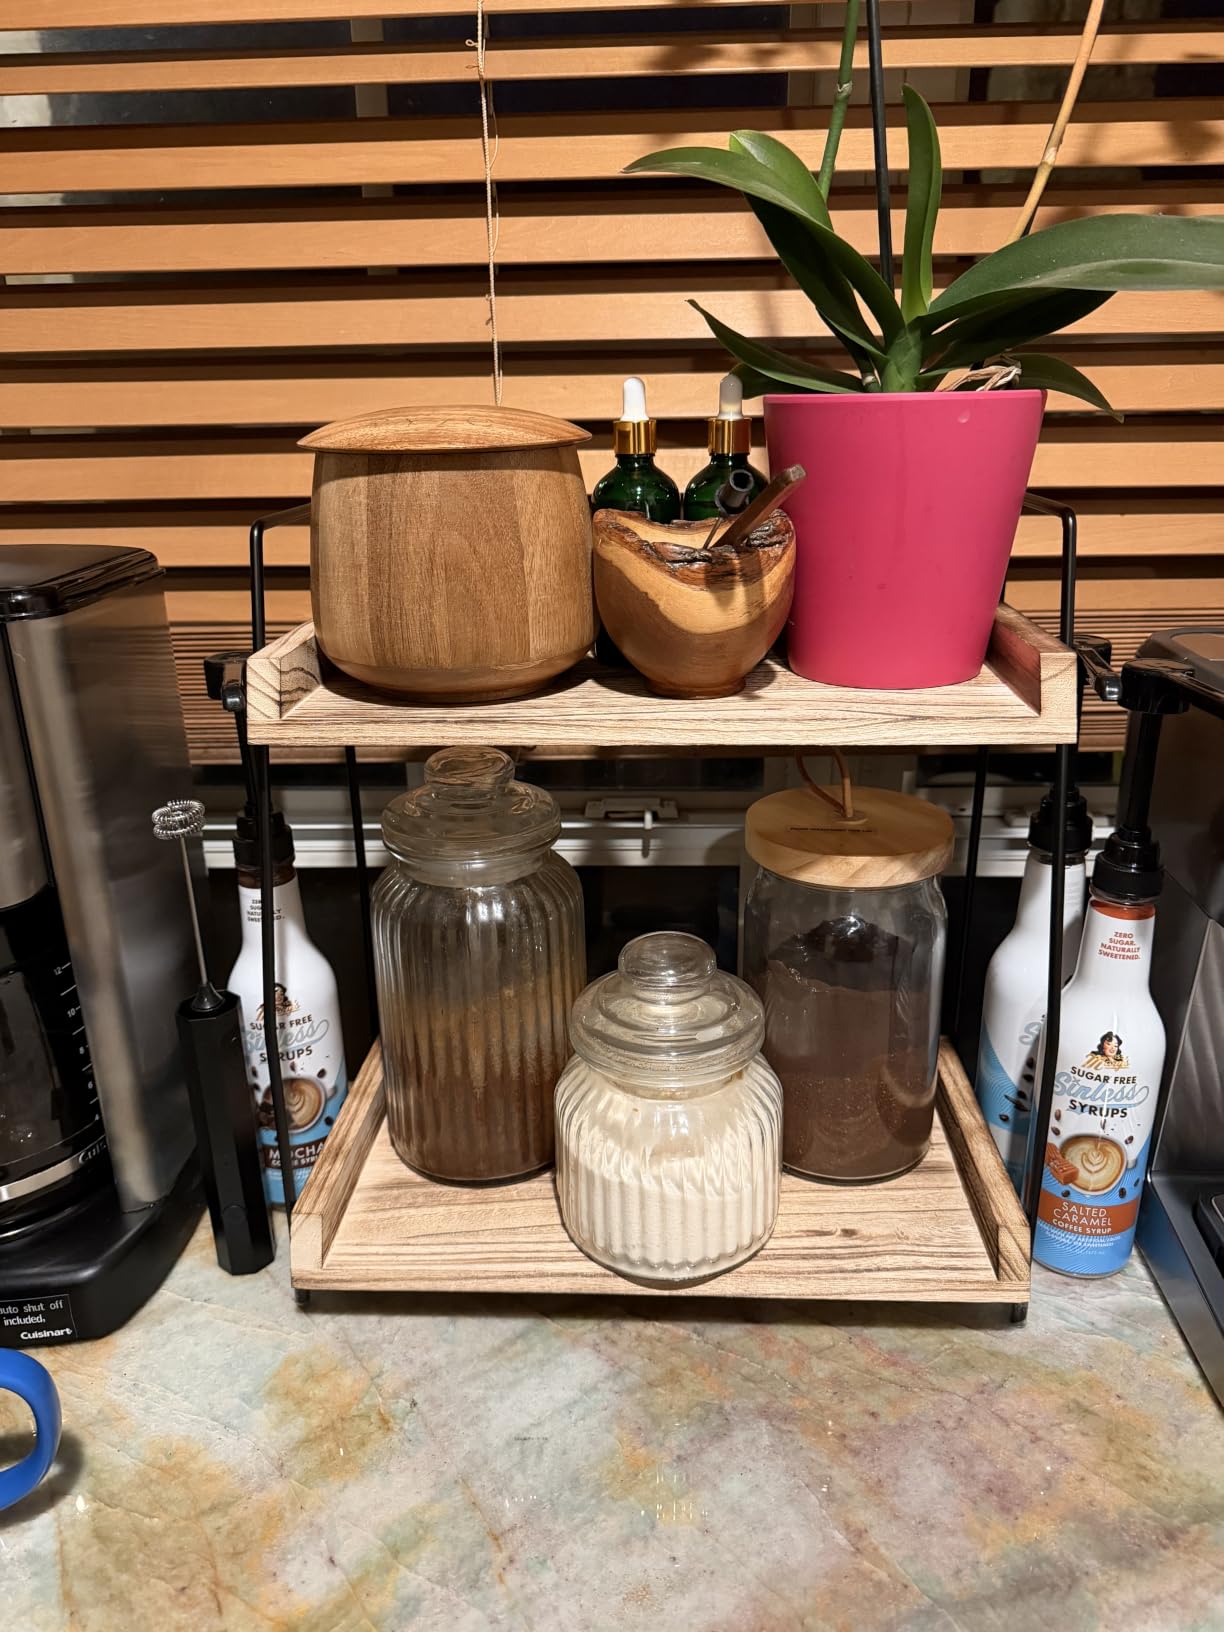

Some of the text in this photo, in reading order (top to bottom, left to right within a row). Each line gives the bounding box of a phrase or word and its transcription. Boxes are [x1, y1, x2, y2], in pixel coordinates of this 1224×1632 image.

[1109, 937, 1136, 946] SUGAR.
[1113, 931, 1133, 939] ZERO
[1100, 943, 1140, 953] NATURALLY
[53, 966, 62, 975] 12
[67, 1007, 76, 1018] 10
[250, 1014, 313, 1031] SUR FREE
[260, 1045, 313, 1062] SRUPS
[1071, 1066, 1137, 1084] SUGAR FREE
[1053, 1071, 1149, 1107] Sinless
[1068, 1099, 1128, 1118] SYRUPS
[269, 1141, 325, 1159] MCHA
[1061, 1201, 1107, 1217] SALTED
[1053, 1209, 1112, 1226] CARAMEL
[1052, 1218, 1083, 1233] COFFEE
[23, 1302, 45, 1313] shut
[49, 1299, 64, 1310] off
[20, 1327, 72, 1340] Cuisinart
